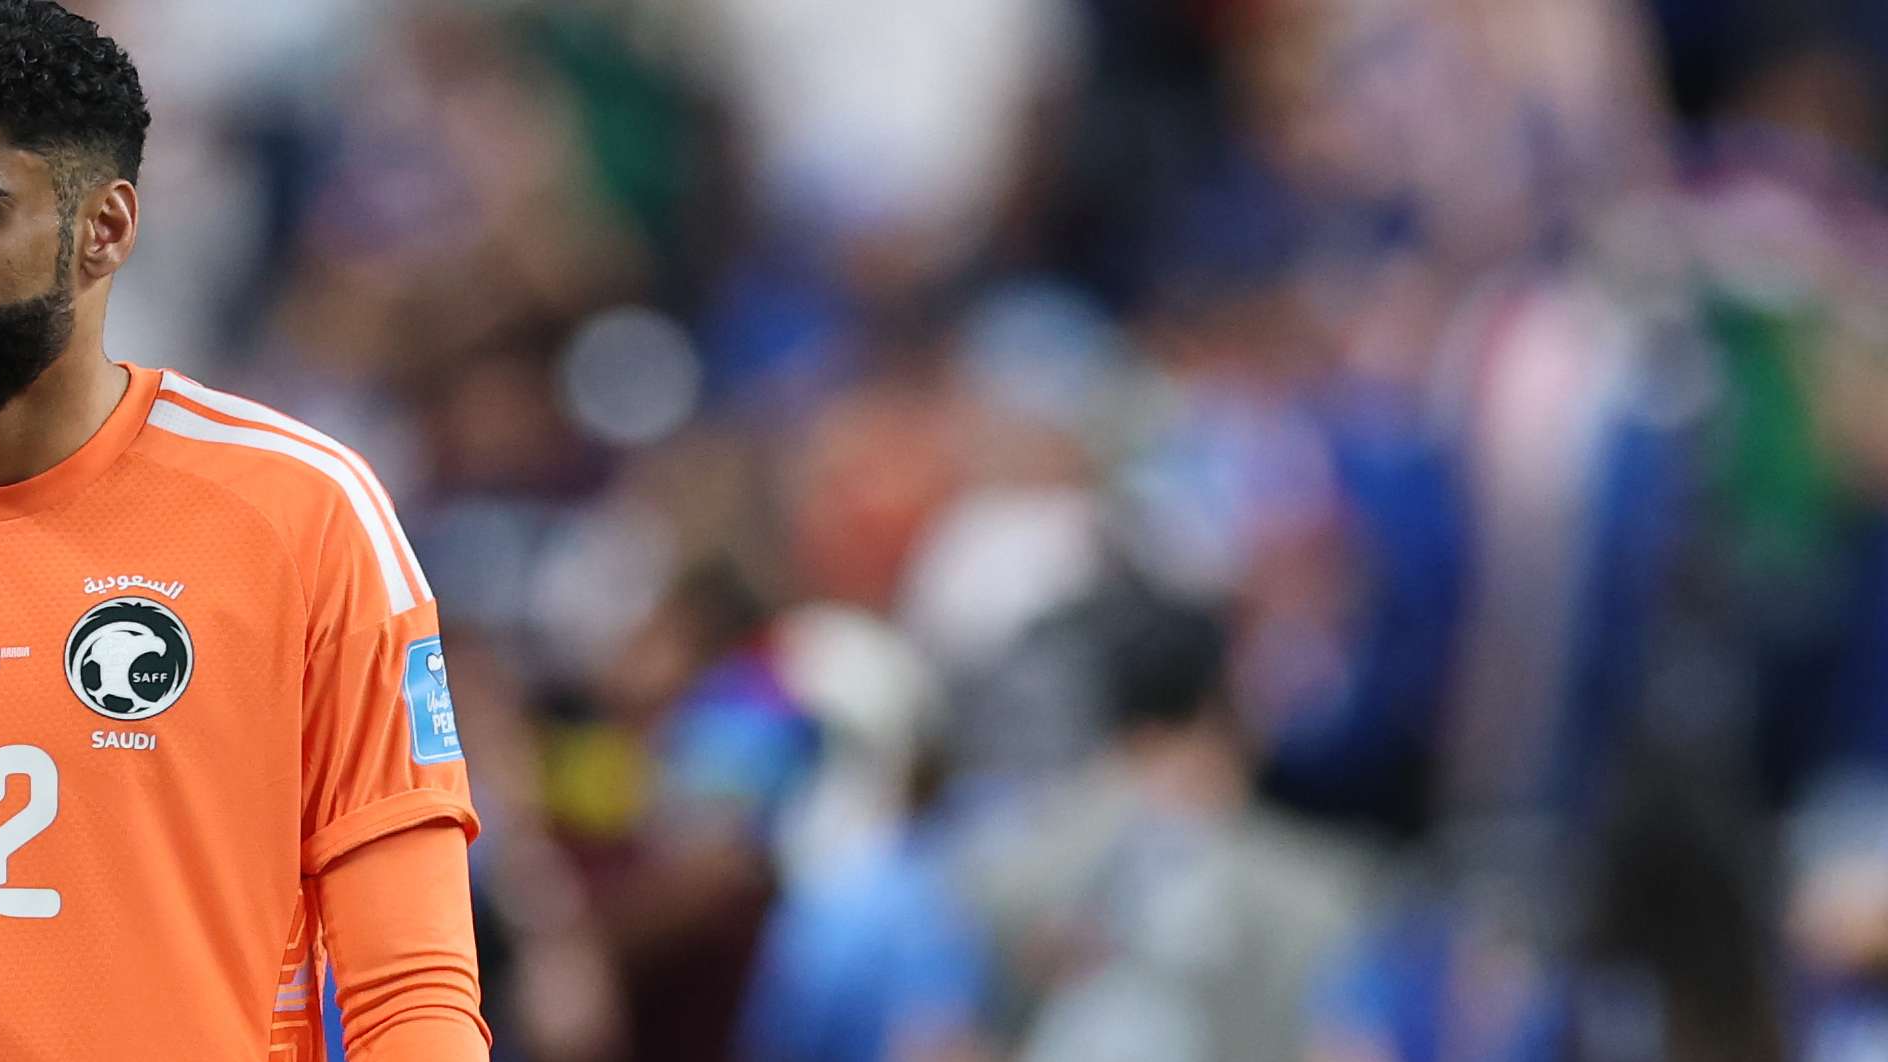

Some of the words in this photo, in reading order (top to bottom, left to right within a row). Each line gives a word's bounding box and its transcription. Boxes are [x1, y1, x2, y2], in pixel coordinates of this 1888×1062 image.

[84, 575, 185, 600] السعودية
[132, 672, 168, 683] SAFF
[91, 730, 157, 751] SAUDI
